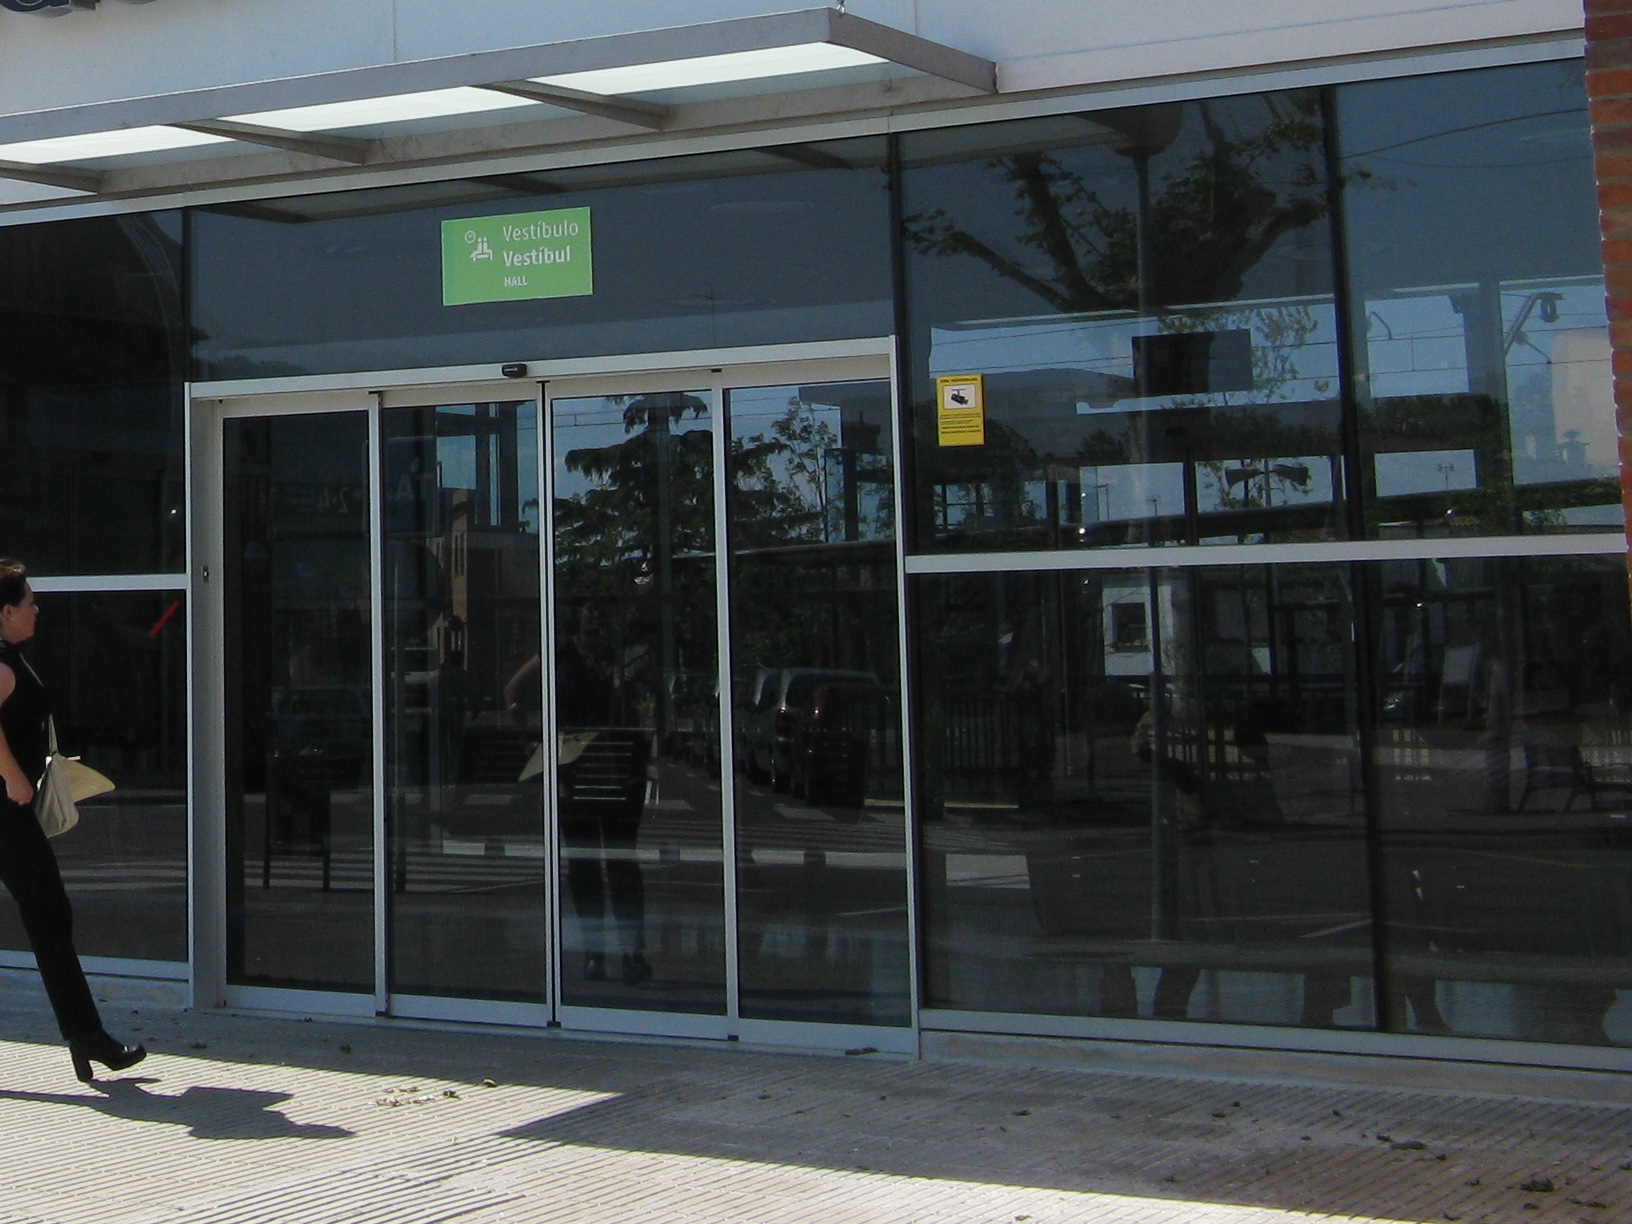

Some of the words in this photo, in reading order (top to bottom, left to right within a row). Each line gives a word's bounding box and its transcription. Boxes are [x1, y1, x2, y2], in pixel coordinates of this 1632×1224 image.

[503, 220, 579, 242] Vestíbulo
[503, 245, 571, 267] Vestíbul
[504, 276, 528, 287] HALL
